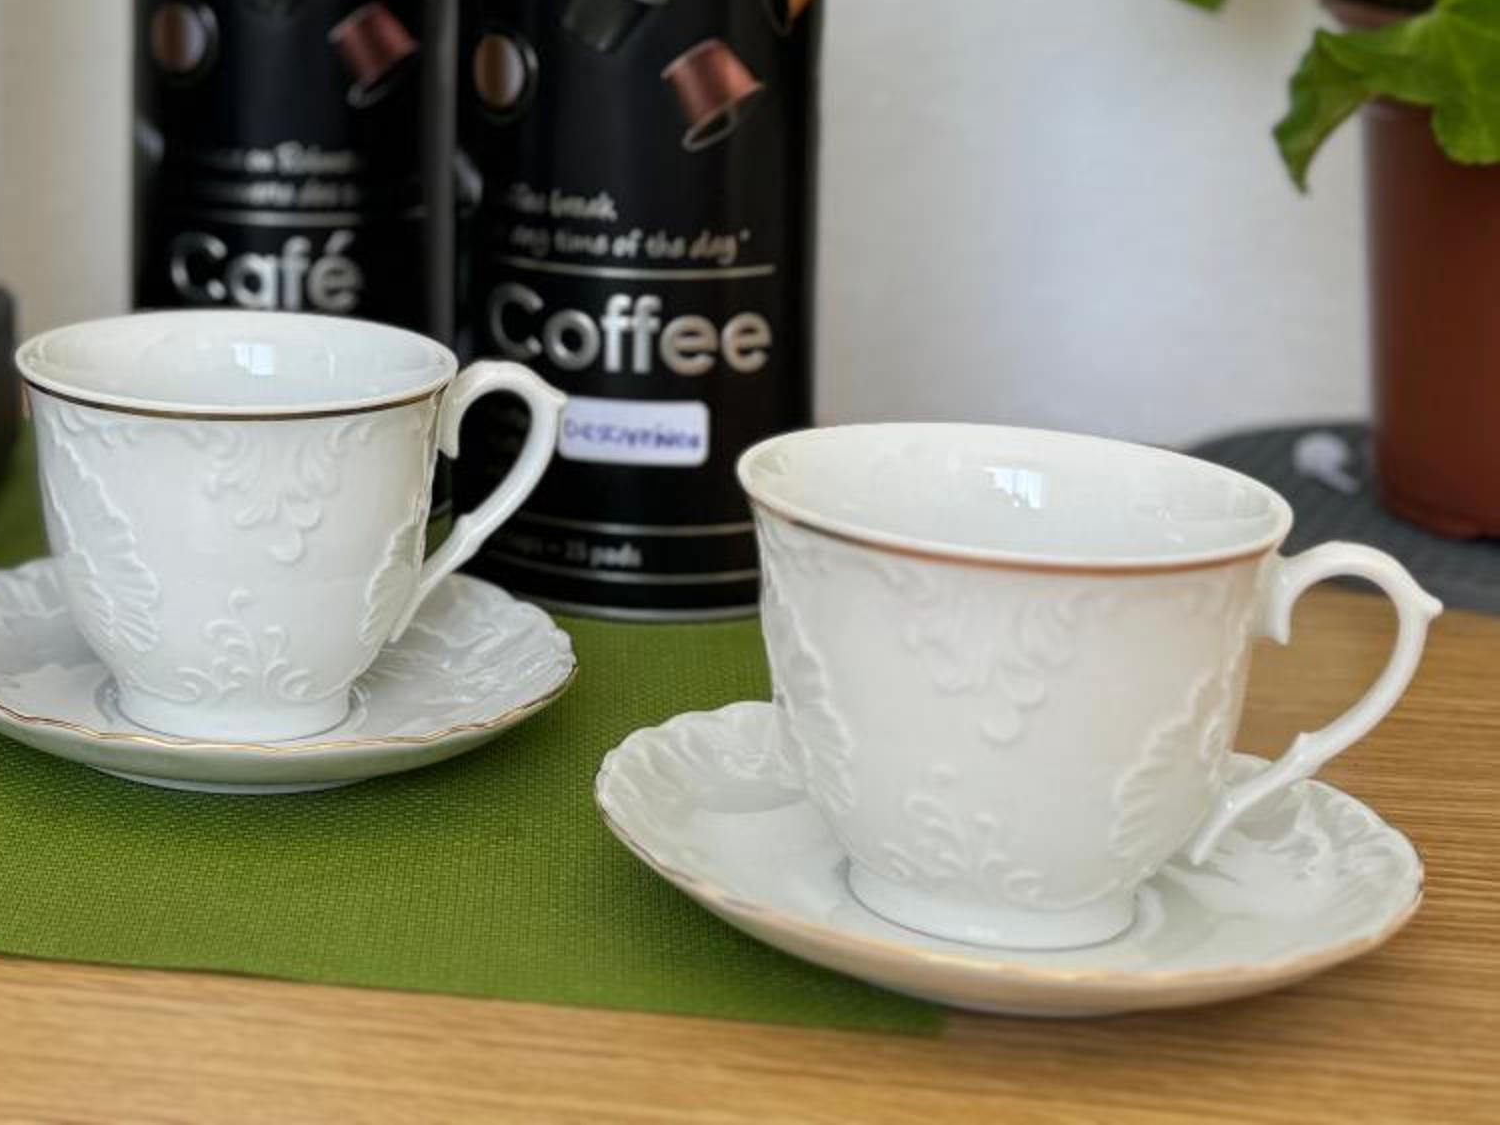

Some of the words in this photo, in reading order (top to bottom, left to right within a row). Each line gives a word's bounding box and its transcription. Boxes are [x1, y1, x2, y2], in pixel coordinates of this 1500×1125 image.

[170, 229, 363, 311] Café
[611, 228, 643, 258] of
[489, 282, 773, 375] Coffee
